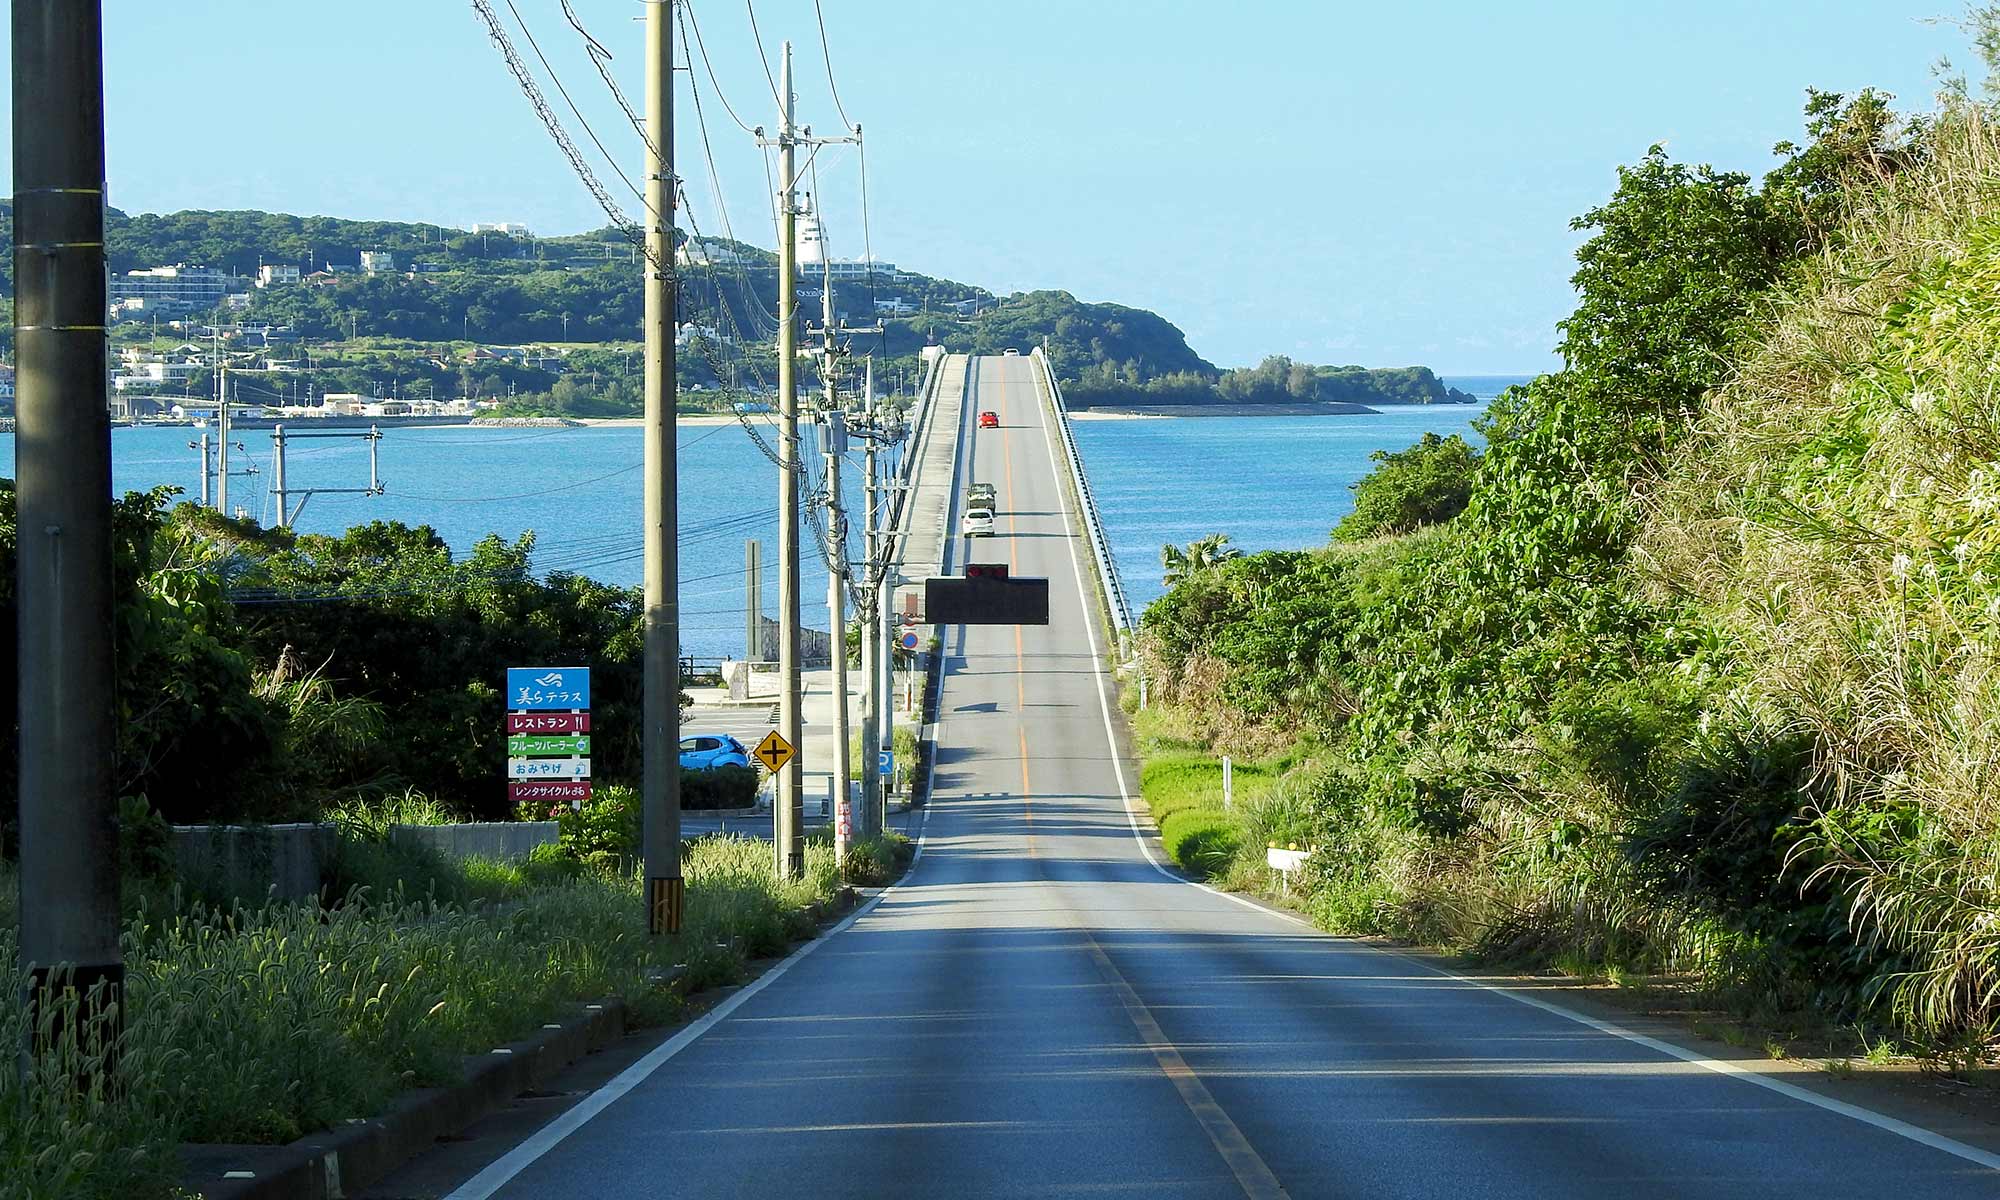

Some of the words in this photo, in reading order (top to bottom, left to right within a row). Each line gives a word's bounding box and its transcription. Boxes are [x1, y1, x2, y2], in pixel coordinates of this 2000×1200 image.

[515, 687, 582, 705] 美らテラス
[514, 718, 568, 728] レストラン
[511, 740, 575, 751] フルーツパーラー
[515, 764, 561, 774] おみやげ
[515, 786, 571, 796] レンタサイクル
